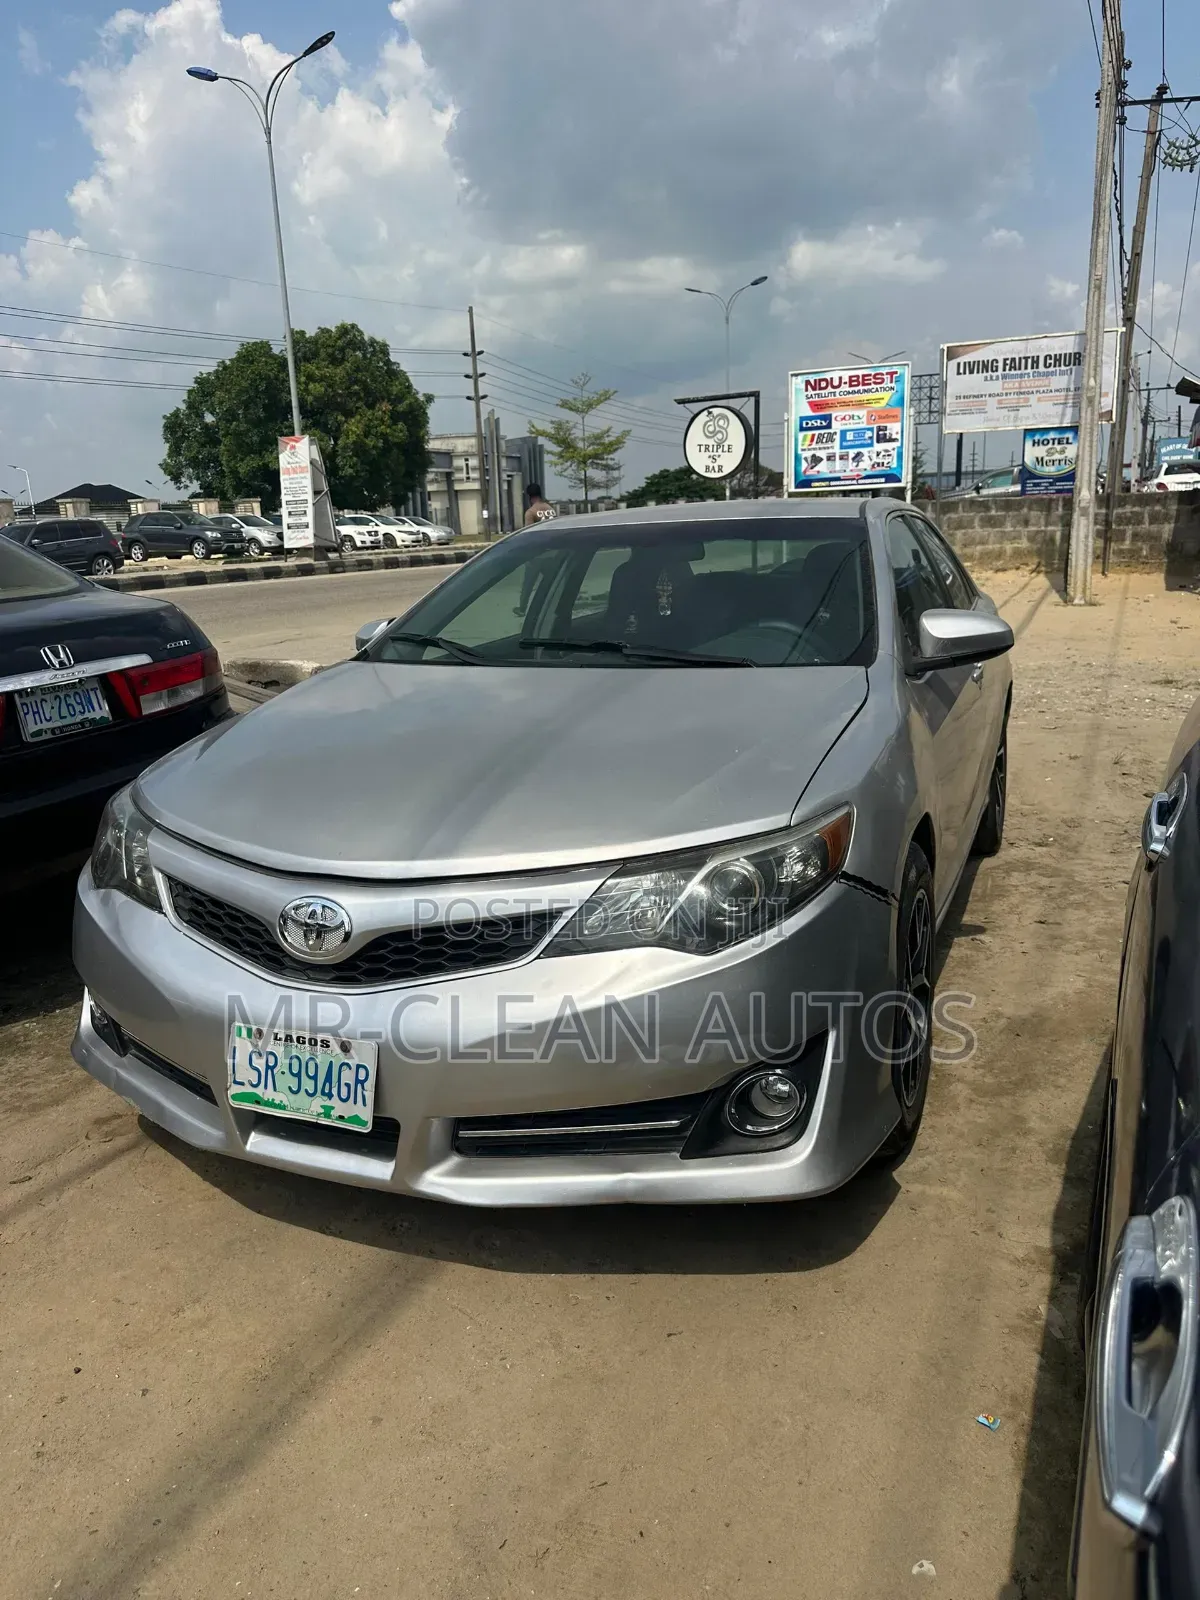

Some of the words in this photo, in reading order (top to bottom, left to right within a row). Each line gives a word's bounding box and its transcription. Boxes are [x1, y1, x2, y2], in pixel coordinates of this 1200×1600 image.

[956, 358, 999, 376] LIVING
[1002, 355, 1040, 372] FAITH
[1043, 352, 1082, 368] CHUR
[804, 370, 899, 392] NDU-BEST
[1001, 371, 1031, 381] Winners
[1032, 369, 1057, 380] Chapel
[805, 390, 837, 400] SATELLITE
[838, 385, 895, 397] COMMUNICATION
[803, 419, 830, 428] DStv
[816, 431, 838, 444] BEDC
[1032, 437, 1073, 447] HOTEL
[697, 444, 733, 453] TRIPLE
[1035, 456, 1074, 468] Merris
[704, 465, 724, 473] BAR
[62, 724, 82, 732] HONDA
[273, 1032, 331, 1049] LAGOS
[232, 1046, 370, 1107] LSR-994GR
